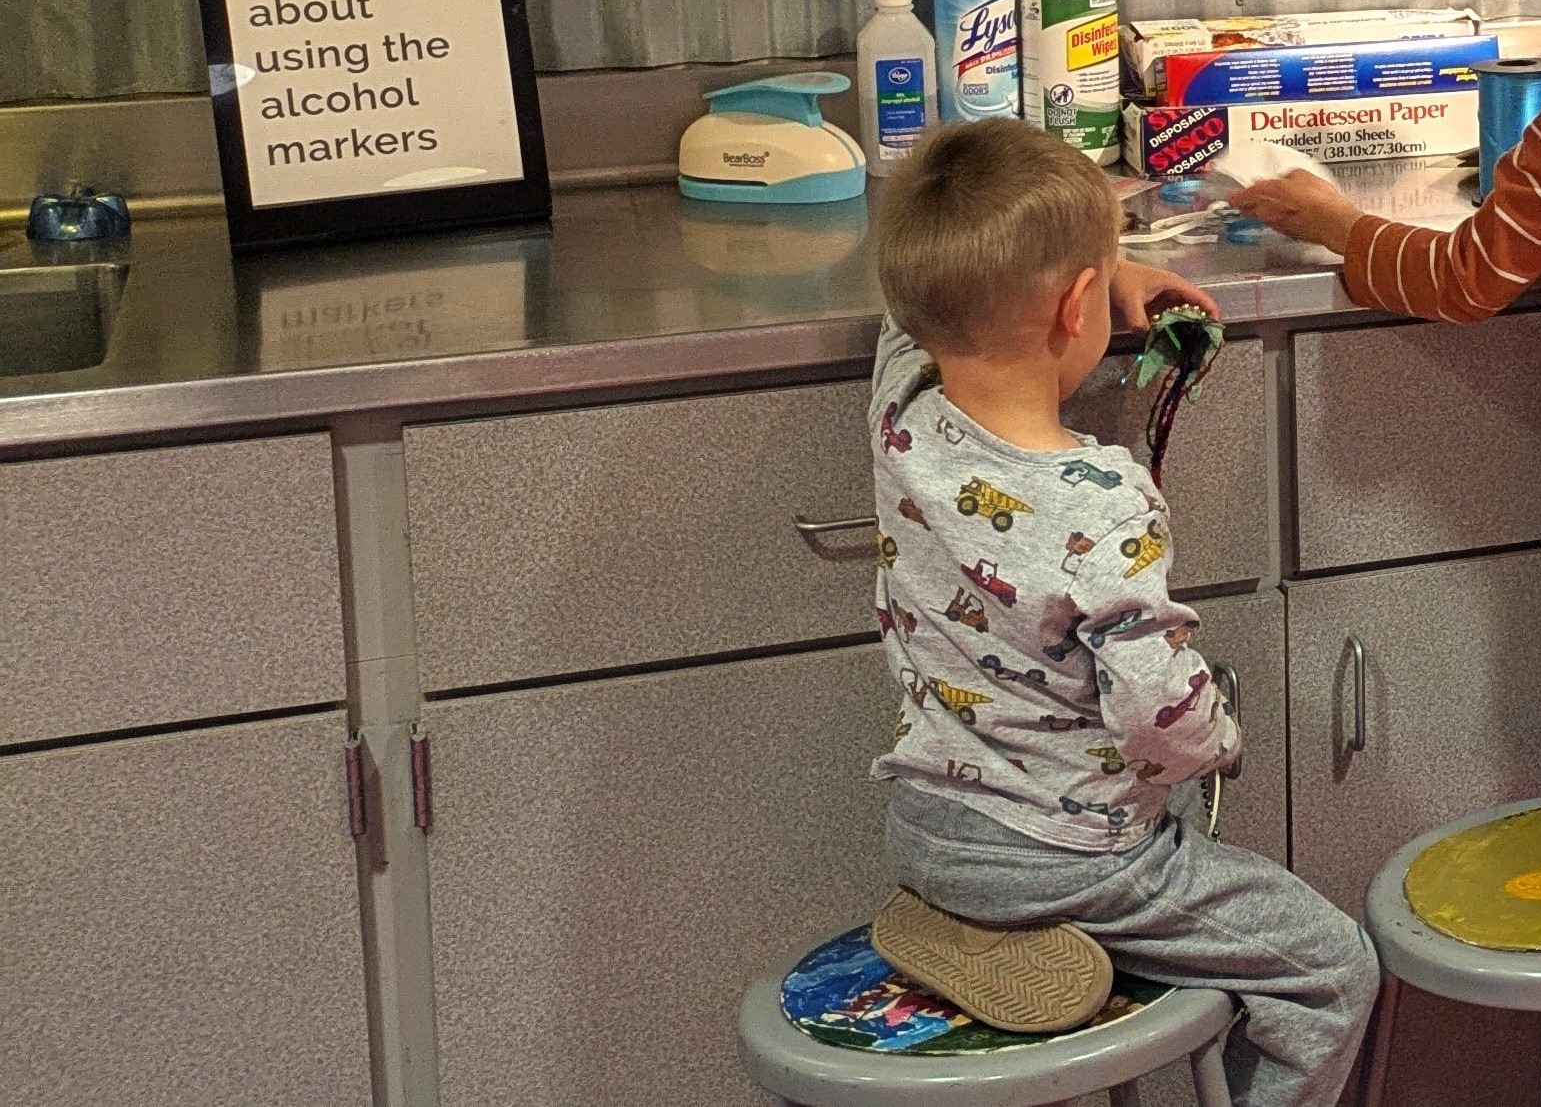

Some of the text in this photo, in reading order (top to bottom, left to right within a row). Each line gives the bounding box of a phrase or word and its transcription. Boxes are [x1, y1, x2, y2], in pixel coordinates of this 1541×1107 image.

[255, 32, 450, 74] using the
[261, 77, 420, 120] alcohol
[1251, 101, 1449, 131] Delicatessen Paper
[267, 127, 438, 166] markers
[1148, 117, 1225, 172] SYSCO
[1323, 140, 1427, 160] (38.10x27.30cm)
[1326, 130, 1350, 144] 500
[1355, 128, 1396, 142] Sheets
